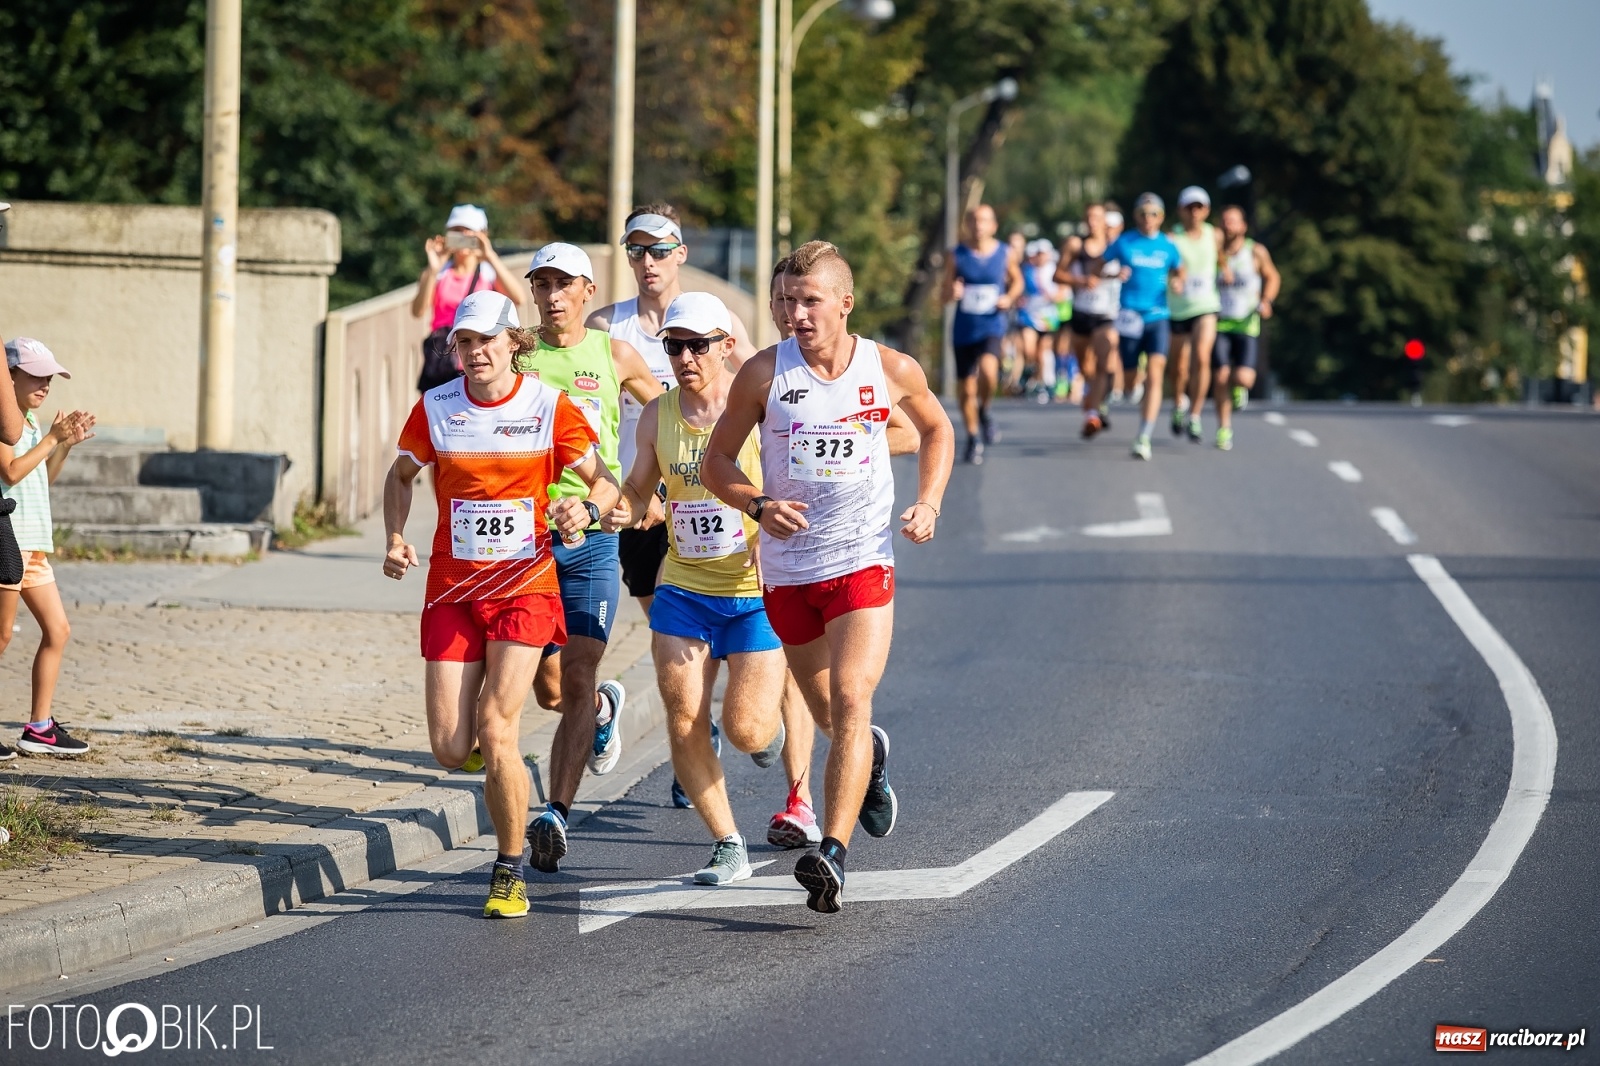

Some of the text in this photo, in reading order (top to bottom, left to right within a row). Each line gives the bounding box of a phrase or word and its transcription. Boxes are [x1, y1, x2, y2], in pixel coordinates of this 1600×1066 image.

[574, 370, 601, 381] EASY
[577, 379, 597, 388] RUN
[433, 390, 461, 402] deep
[780, 389, 809, 405] 4F
[493, 424, 542, 435] FENIKS
[689, 447, 705, 462] TH
[815, 438, 854, 458] 373
[669, 461, 702, 476] NOR
[683, 474, 701, 487] FA
[475, 516, 515, 536] 285
[690, 514, 725, 536] 132
